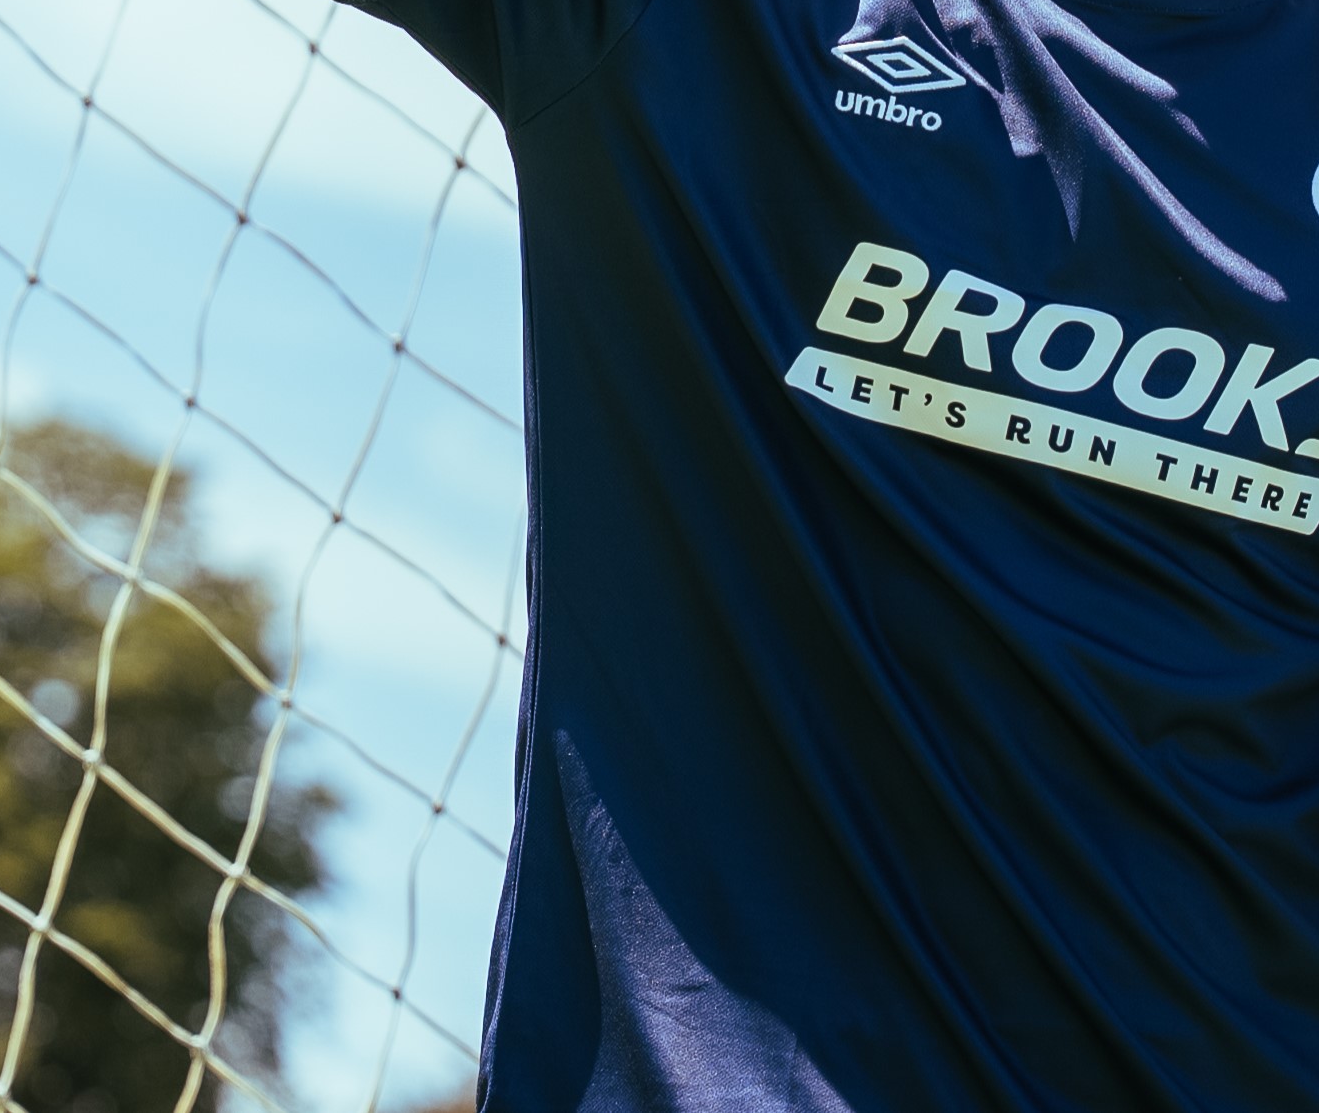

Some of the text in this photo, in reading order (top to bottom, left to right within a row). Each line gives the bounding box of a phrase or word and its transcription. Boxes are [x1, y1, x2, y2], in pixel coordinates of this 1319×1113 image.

[835, 90, 942, 131] umbro
[815, 366, 1312, 519] LET'S RUN THERE
